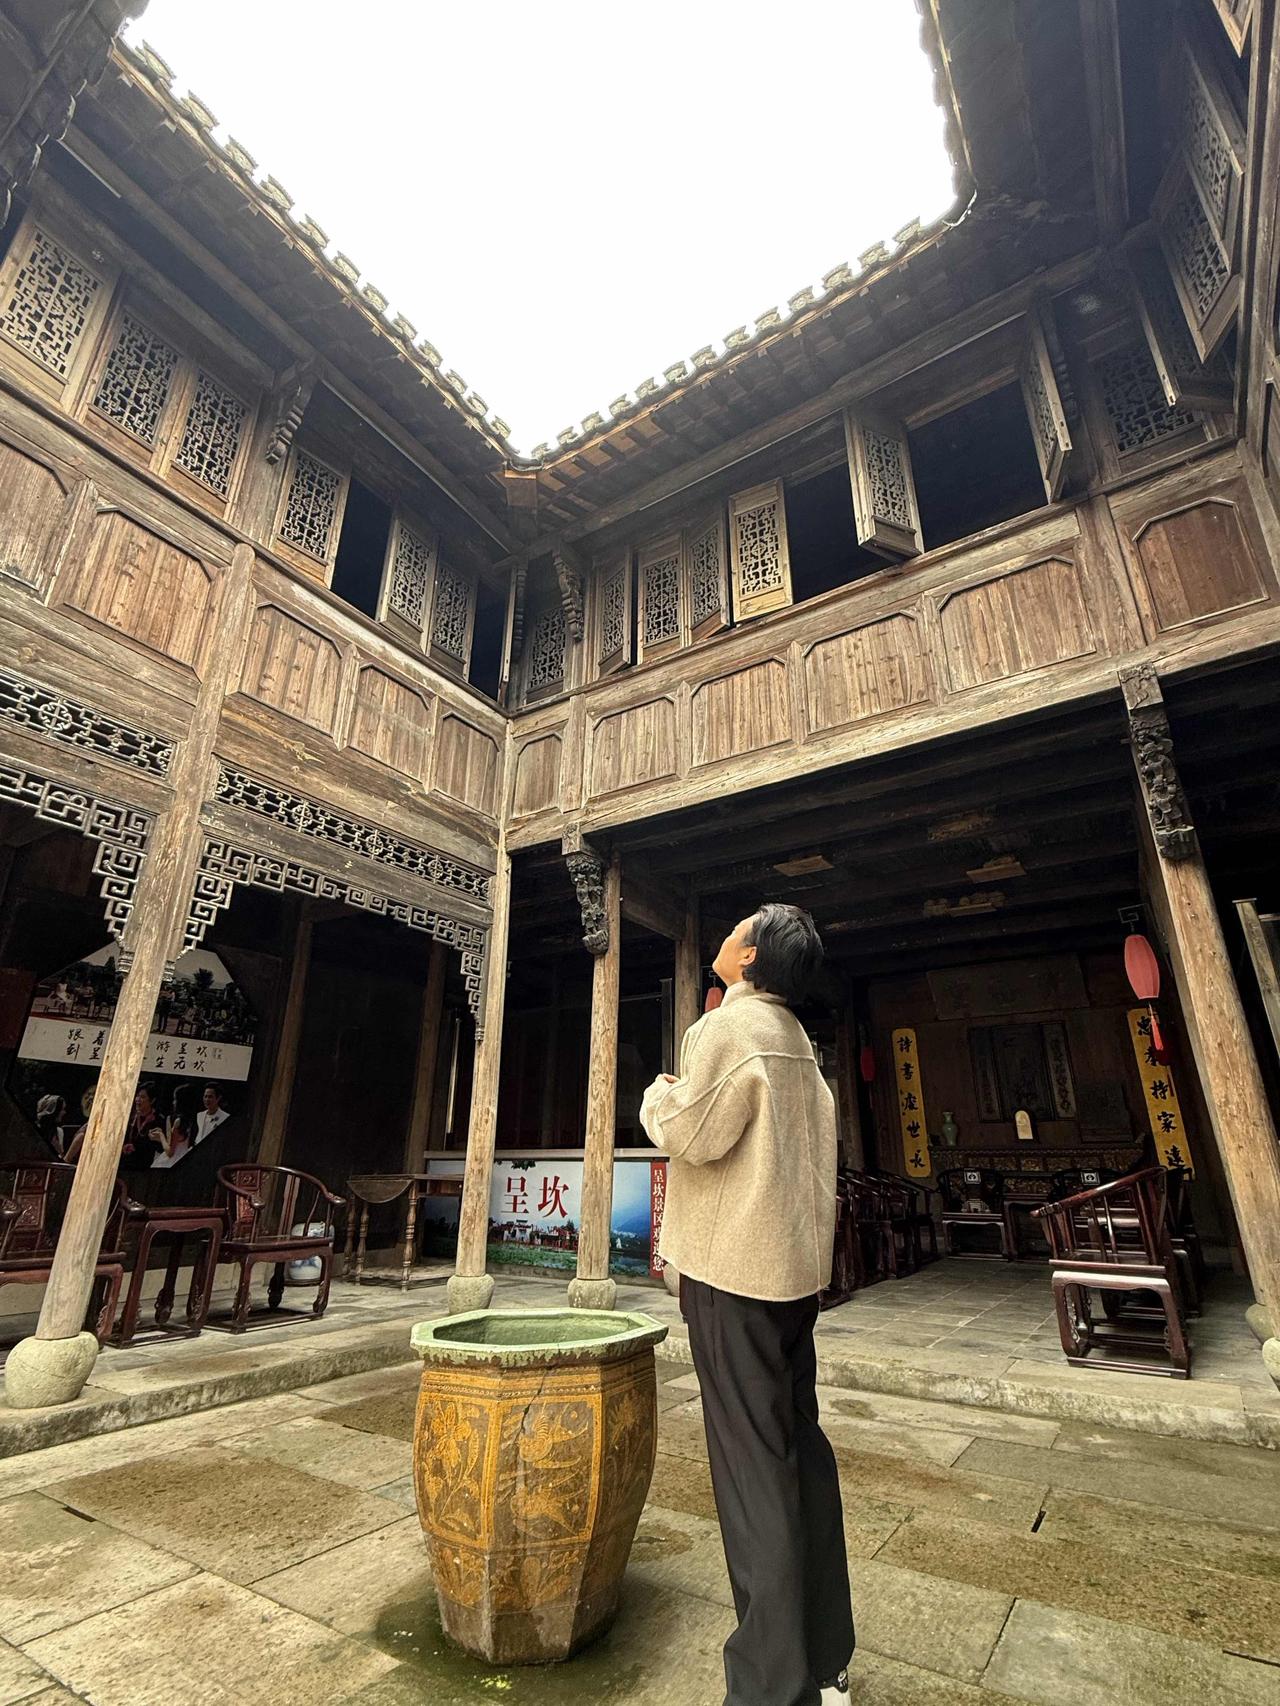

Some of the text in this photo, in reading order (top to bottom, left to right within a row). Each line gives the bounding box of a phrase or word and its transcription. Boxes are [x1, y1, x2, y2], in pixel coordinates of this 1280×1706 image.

[66, 1043, 205, 1072] 到呈生无坎
[67, 1028, 208, 1058] 跟着游呈坎
[501, 1175, 569, 1218] 呈坎
